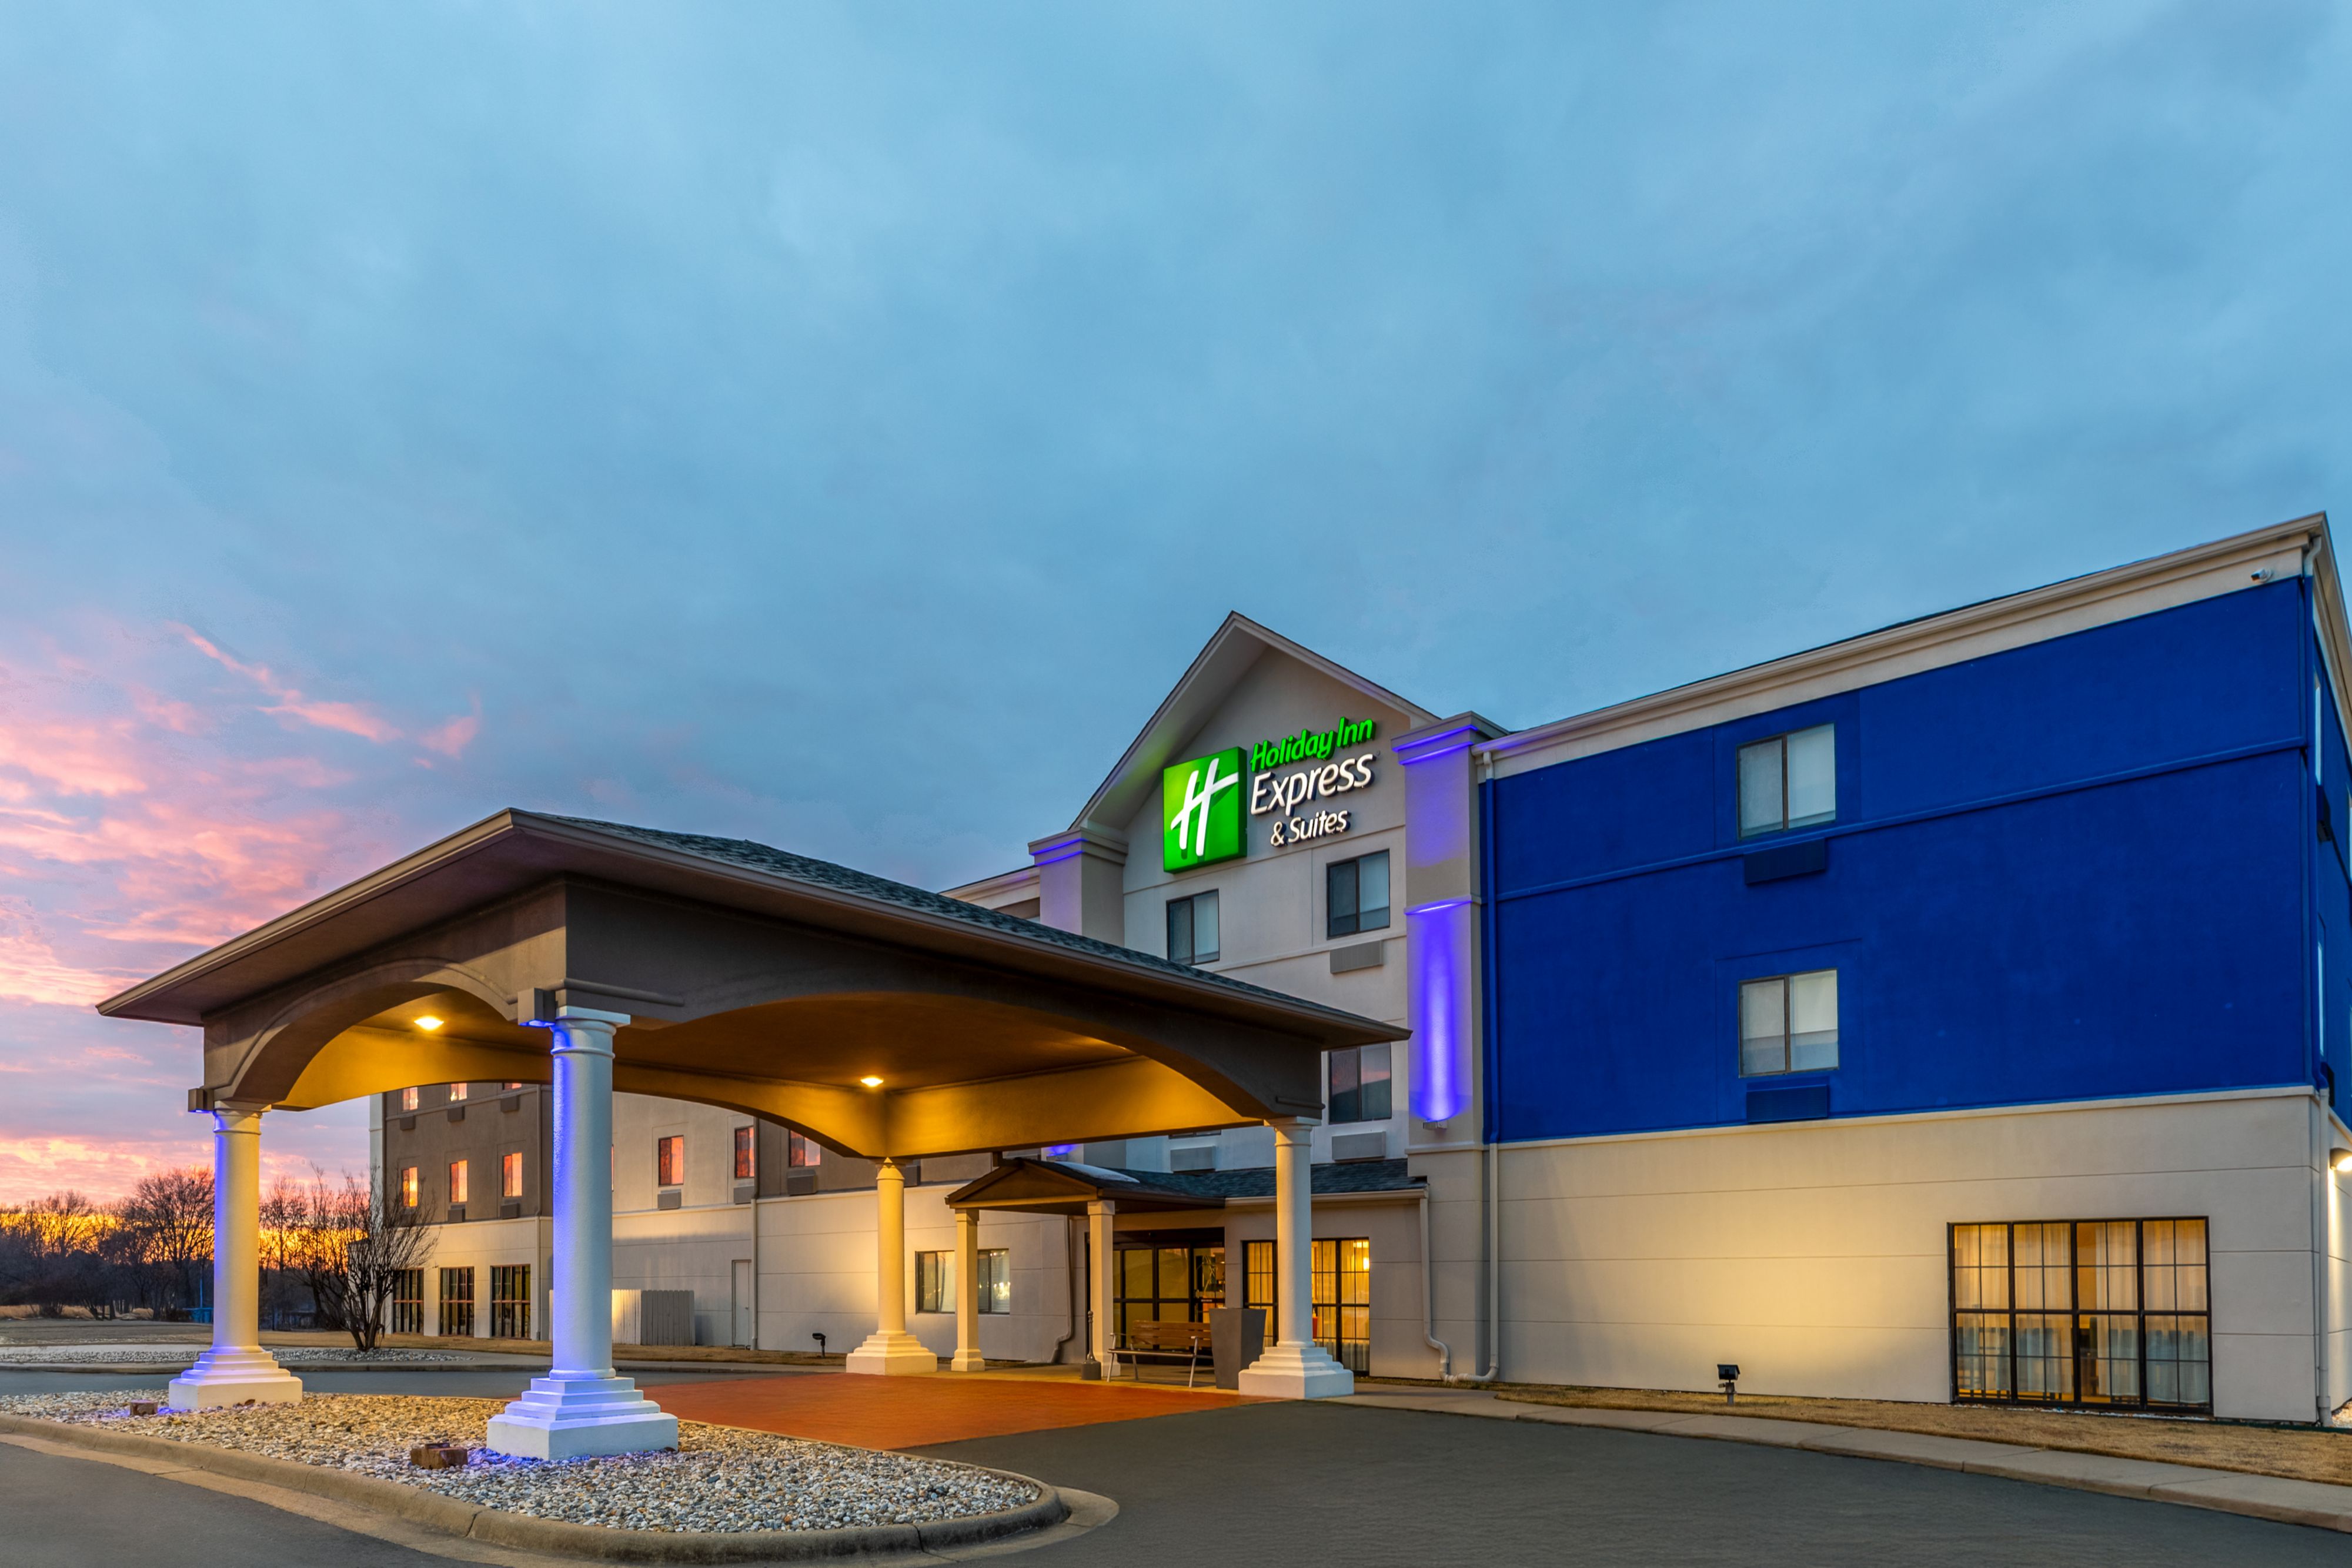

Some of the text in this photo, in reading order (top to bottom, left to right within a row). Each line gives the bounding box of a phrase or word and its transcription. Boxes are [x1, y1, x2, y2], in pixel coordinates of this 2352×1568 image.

[1250, 717, 1374, 772] Holiday Inn
[1250, 754, 1374, 816] Express
[1270, 810, 1349, 847] & Suites
